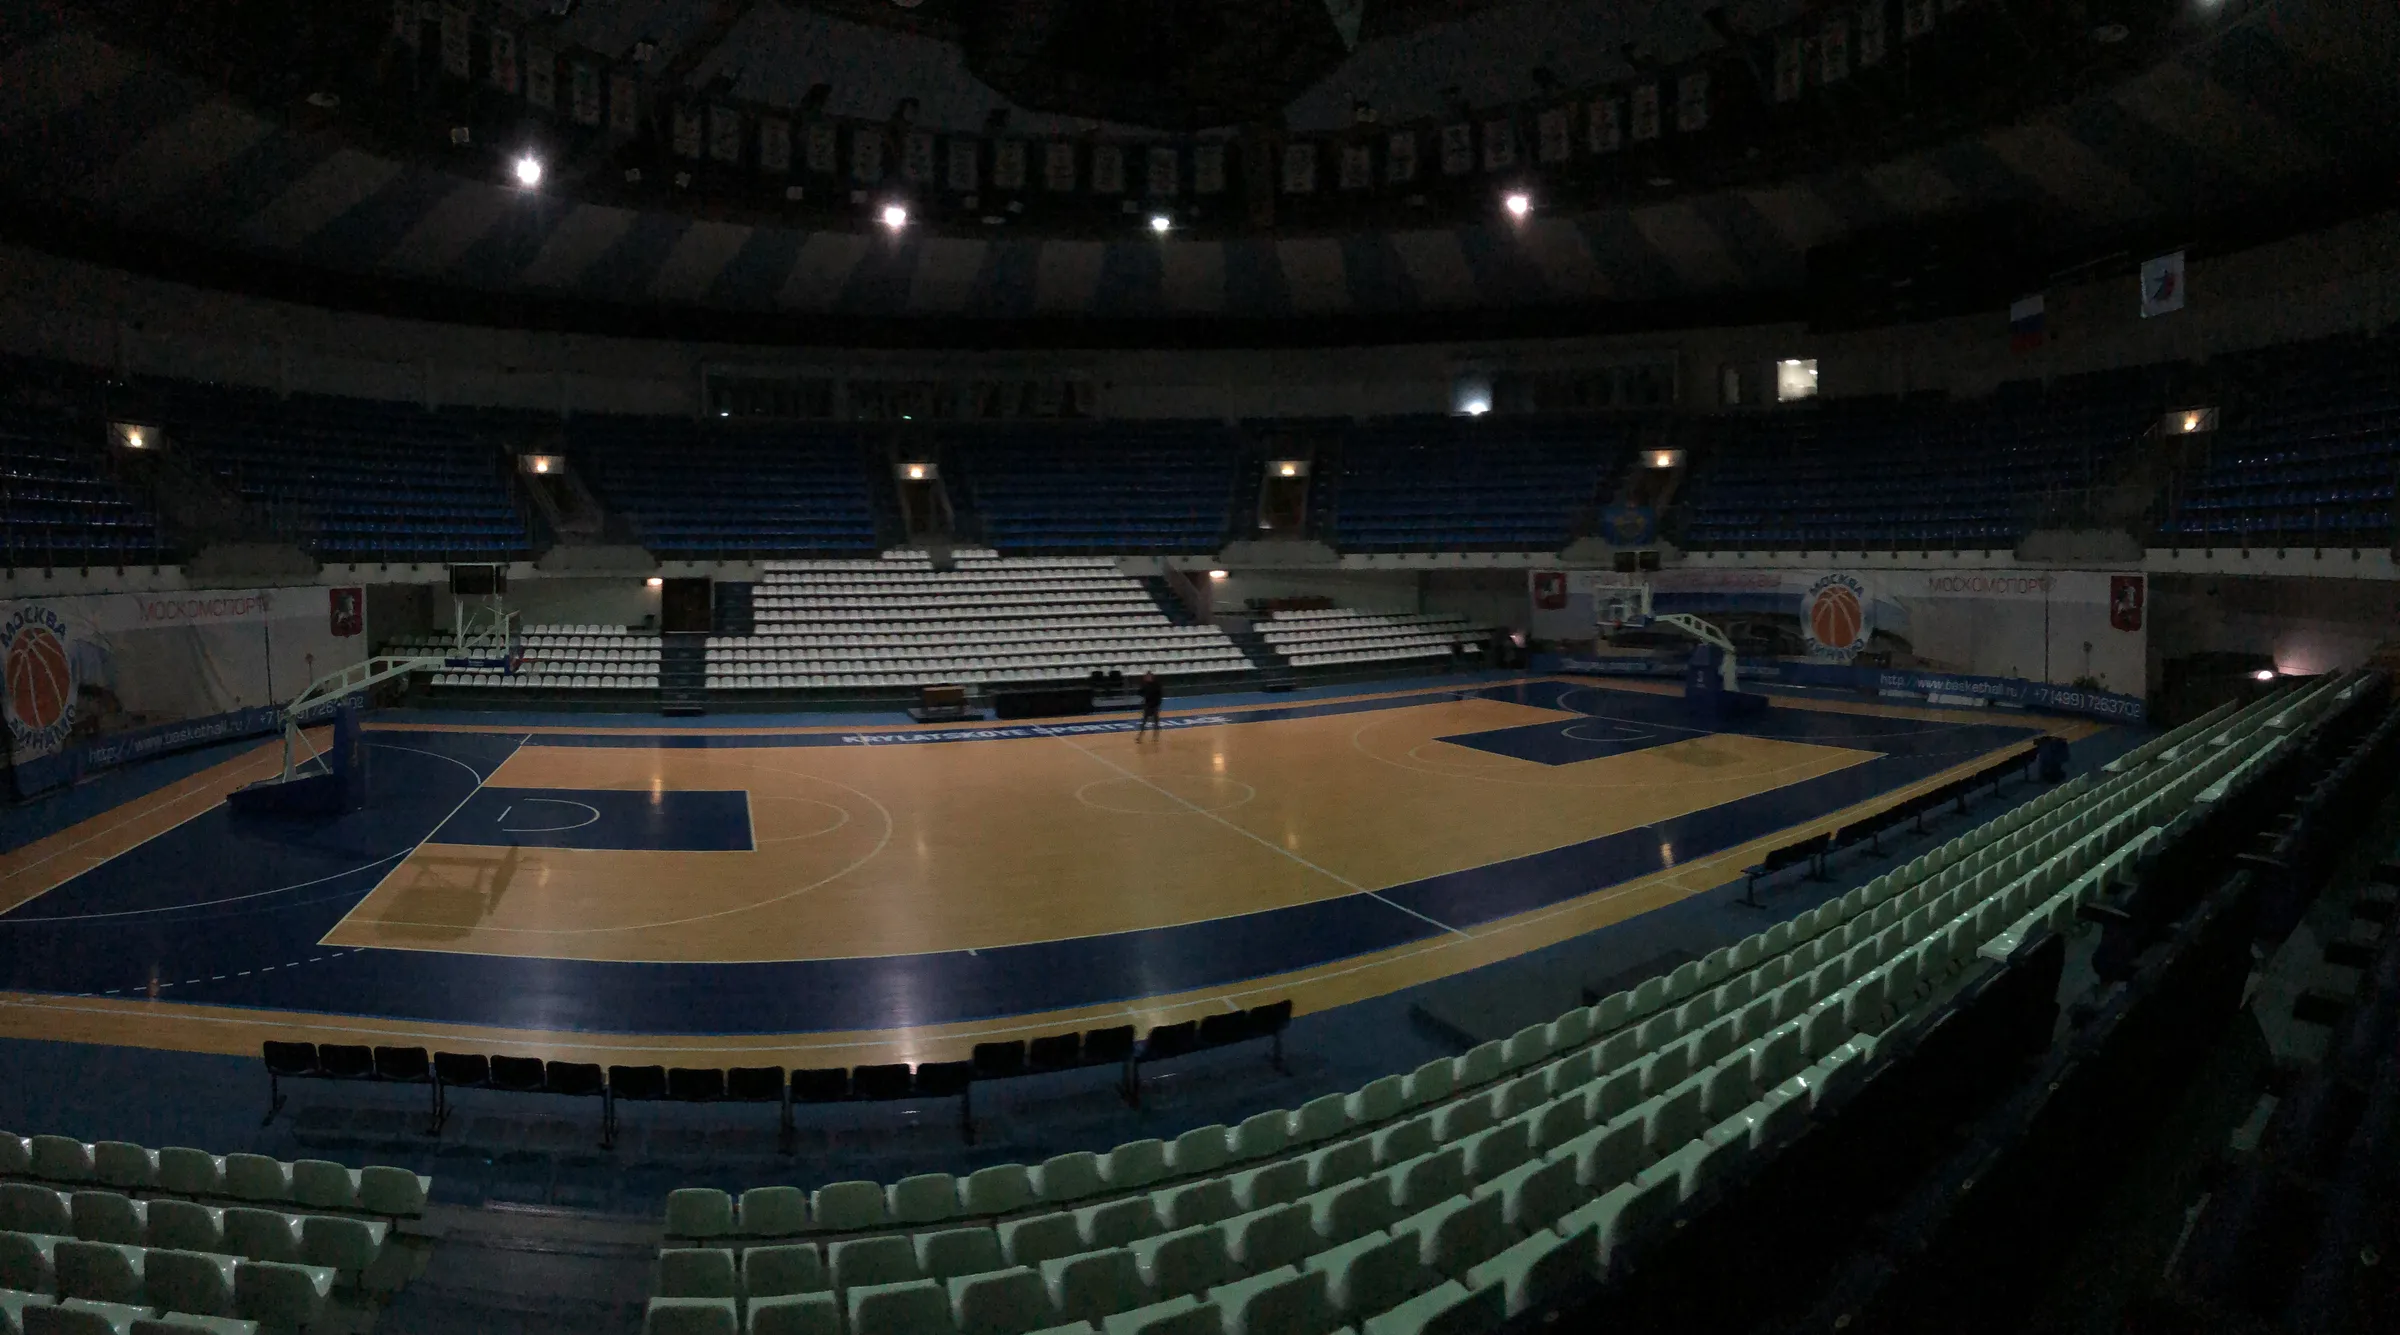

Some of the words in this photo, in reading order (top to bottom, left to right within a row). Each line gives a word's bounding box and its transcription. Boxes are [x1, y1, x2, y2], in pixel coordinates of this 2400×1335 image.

[1808, 573, 1865, 598] МОСКВА
[139, 596, 265, 621] МОСКОМСПОРТ
[0, 605, 67, 647] МОСКВА
[2050, 689, 2085, 709] (499)
[2087, 694, 2141, 718] 7263702
[841, 727, 1031, 743] KRYLATSKOYE
[1031, 722, 1135, 736] SPORTS
